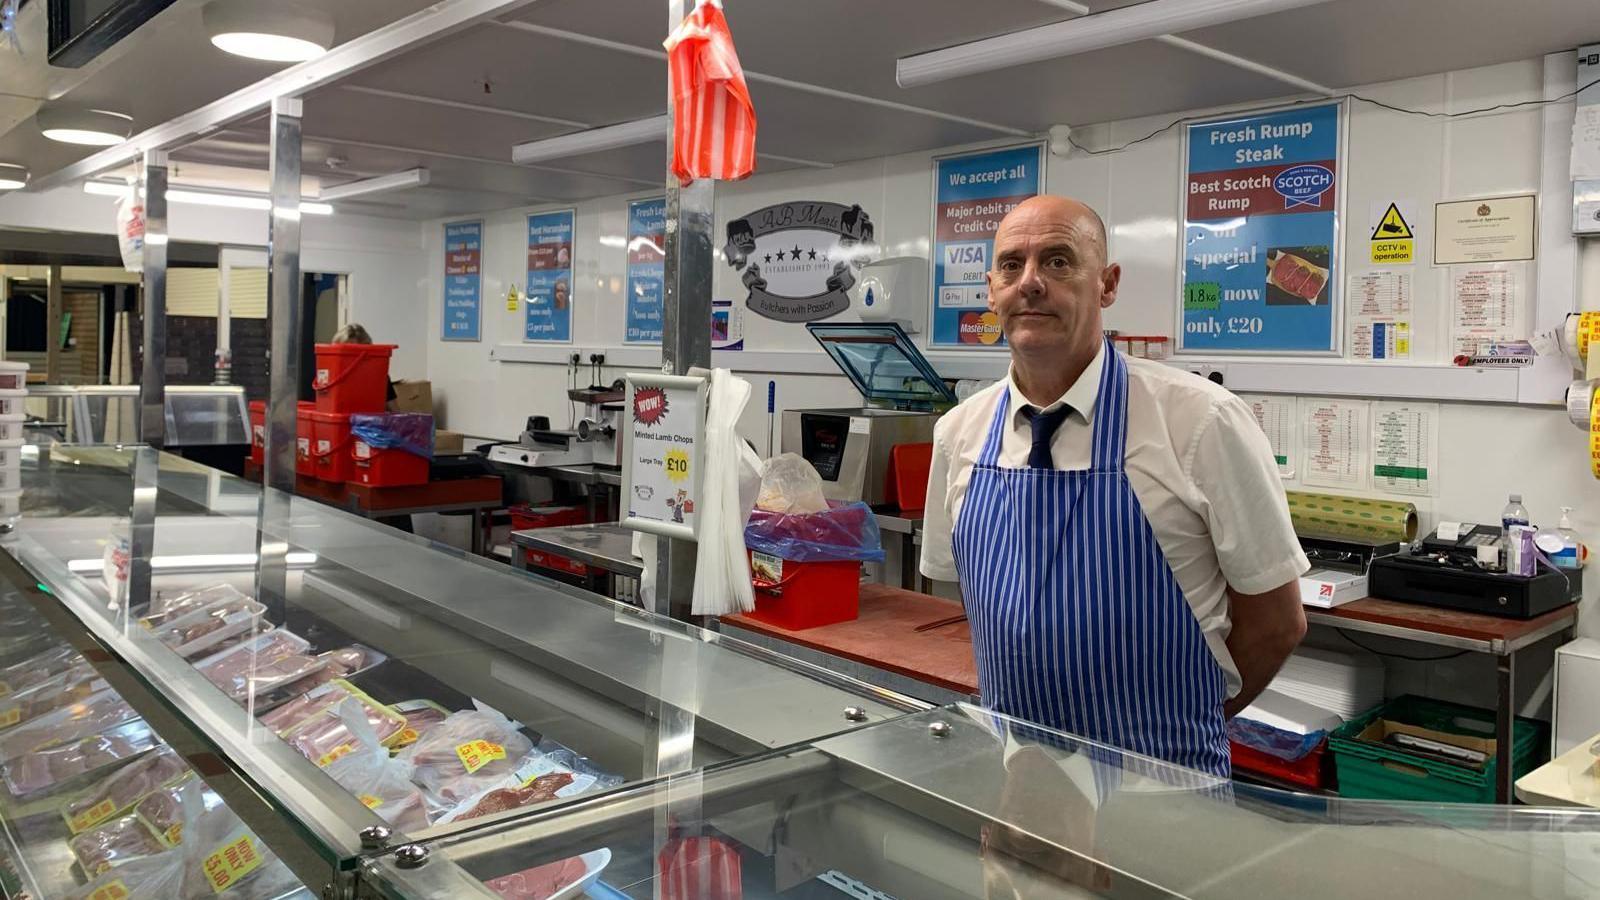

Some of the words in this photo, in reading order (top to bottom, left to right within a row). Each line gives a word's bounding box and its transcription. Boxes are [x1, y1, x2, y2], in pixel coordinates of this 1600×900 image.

[1210, 125, 1256, 145] Fresh
[1260, 121, 1313, 143] Rump
[1235, 144, 1284, 164] Steak
[949, 173, 967, 186] We
[968, 169, 1007, 185] accept
[1009, 165, 1025, 179] all
[1278, 174, 1330, 188] SCOTCH
[1190, 181, 1220, 194] Best
[1223, 174, 1272, 191] Scotch
[1294, 187, 1312, 195] BEEF
[946, 206, 975, 219] Major
[975, 203, 1003, 215] Debit
[1004, 203, 1018, 212] an
[1208, 197, 1250, 211] Rump
[796, 205, 838, 228] Meats
[954, 221, 984, 233] Credit
[949, 246, 984, 264] VISA
[1193, 241, 1257, 270] special
[1377, 244, 1398, 252] CCTV
[1399, 243, 1407, 251] in
[1374, 252, 1409, 262] operation
[765, 264, 812, 274] ESTABLISHED
[963, 272, 983, 281] DEBIT
[1224, 288, 1262, 301] now
[760, 299, 789, 314] Butchers
[790, 304, 806, 314] with
[807, 300, 834, 314] Passion
[960, 323, 1000, 334] MasterCard
[1186, 316, 1225, 338] only
[1227, 317, 1263, 334] £20
[638, 395, 661, 412] WOW!
[634, 430, 655, 440] Minted
[655, 432, 673, 442] Lamb
[673, 434, 694, 444] Chops
[639, 457, 653, 466] Large
[653, 458, 663, 467] Tray
[667, 457, 687, 473] £10
[223, 846, 244, 870] ONLY
[236, 838, 256, 863] NOW
[206, 854, 230, 887] £5.00
